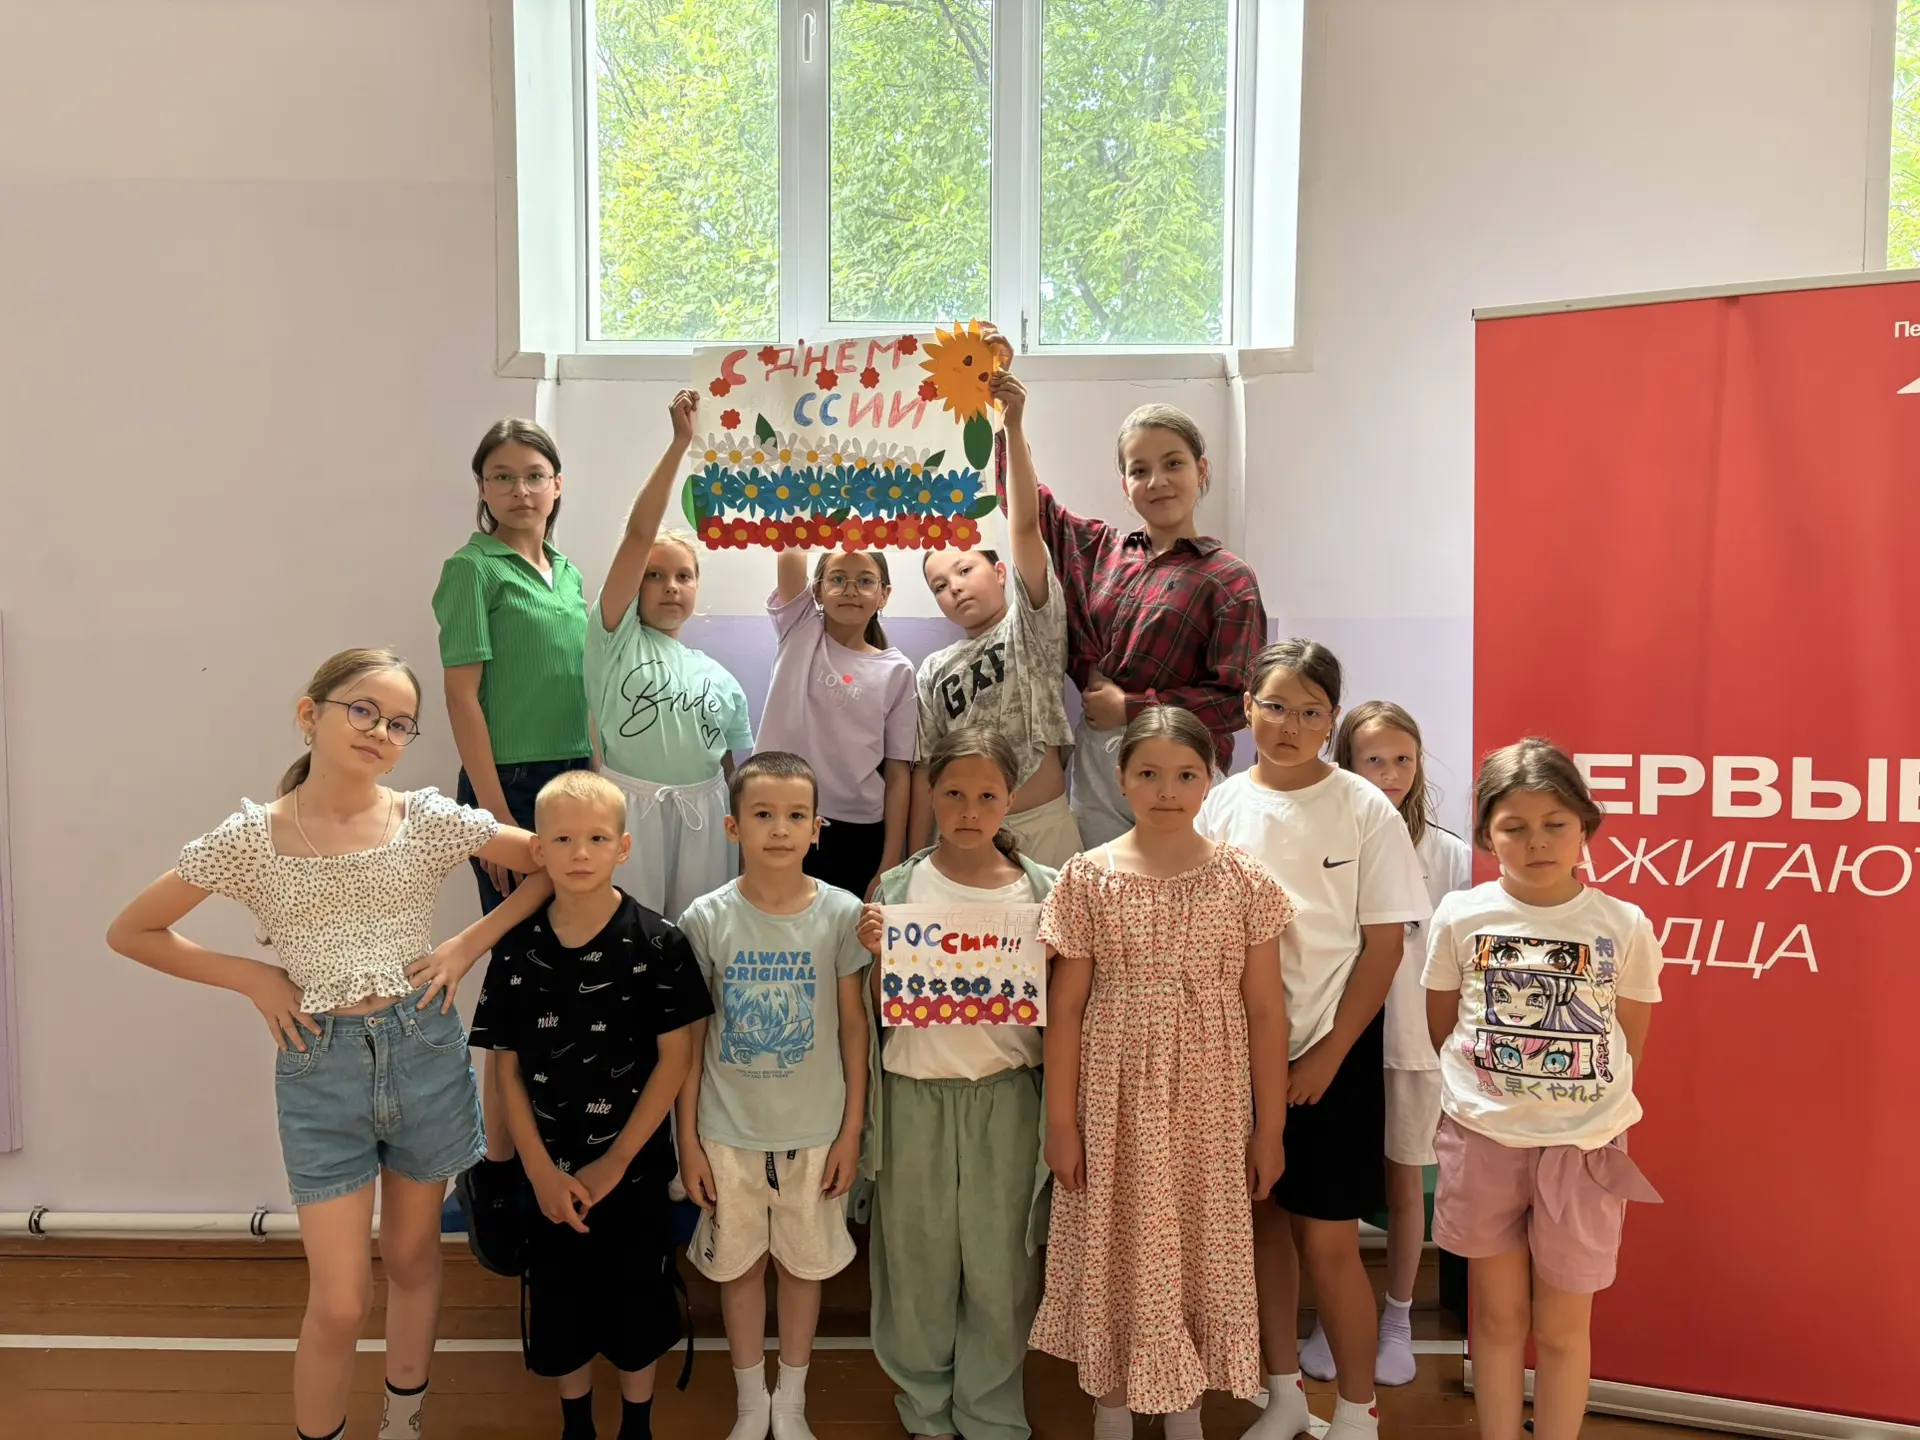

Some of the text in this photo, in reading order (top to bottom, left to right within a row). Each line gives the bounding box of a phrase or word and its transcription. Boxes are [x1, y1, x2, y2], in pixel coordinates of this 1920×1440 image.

[720, 349, 749, 386] С
[619, 659, 721, 738] Bride
[1573, 752, 1920, 823] ЕРВЫ
[1578, 836, 1920, 897] ЖИГАЮ
[733, 950, 812, 966] ALWAYS
[724, 965, 817, 982] ORIGINAL
[537, 1011, 559, 1029] nike
[590, 1021, 607, 1032] nike
[1504, 1076, 1606, 1102] 早くやれよ
[585, 1098, 613, 1115] nike
